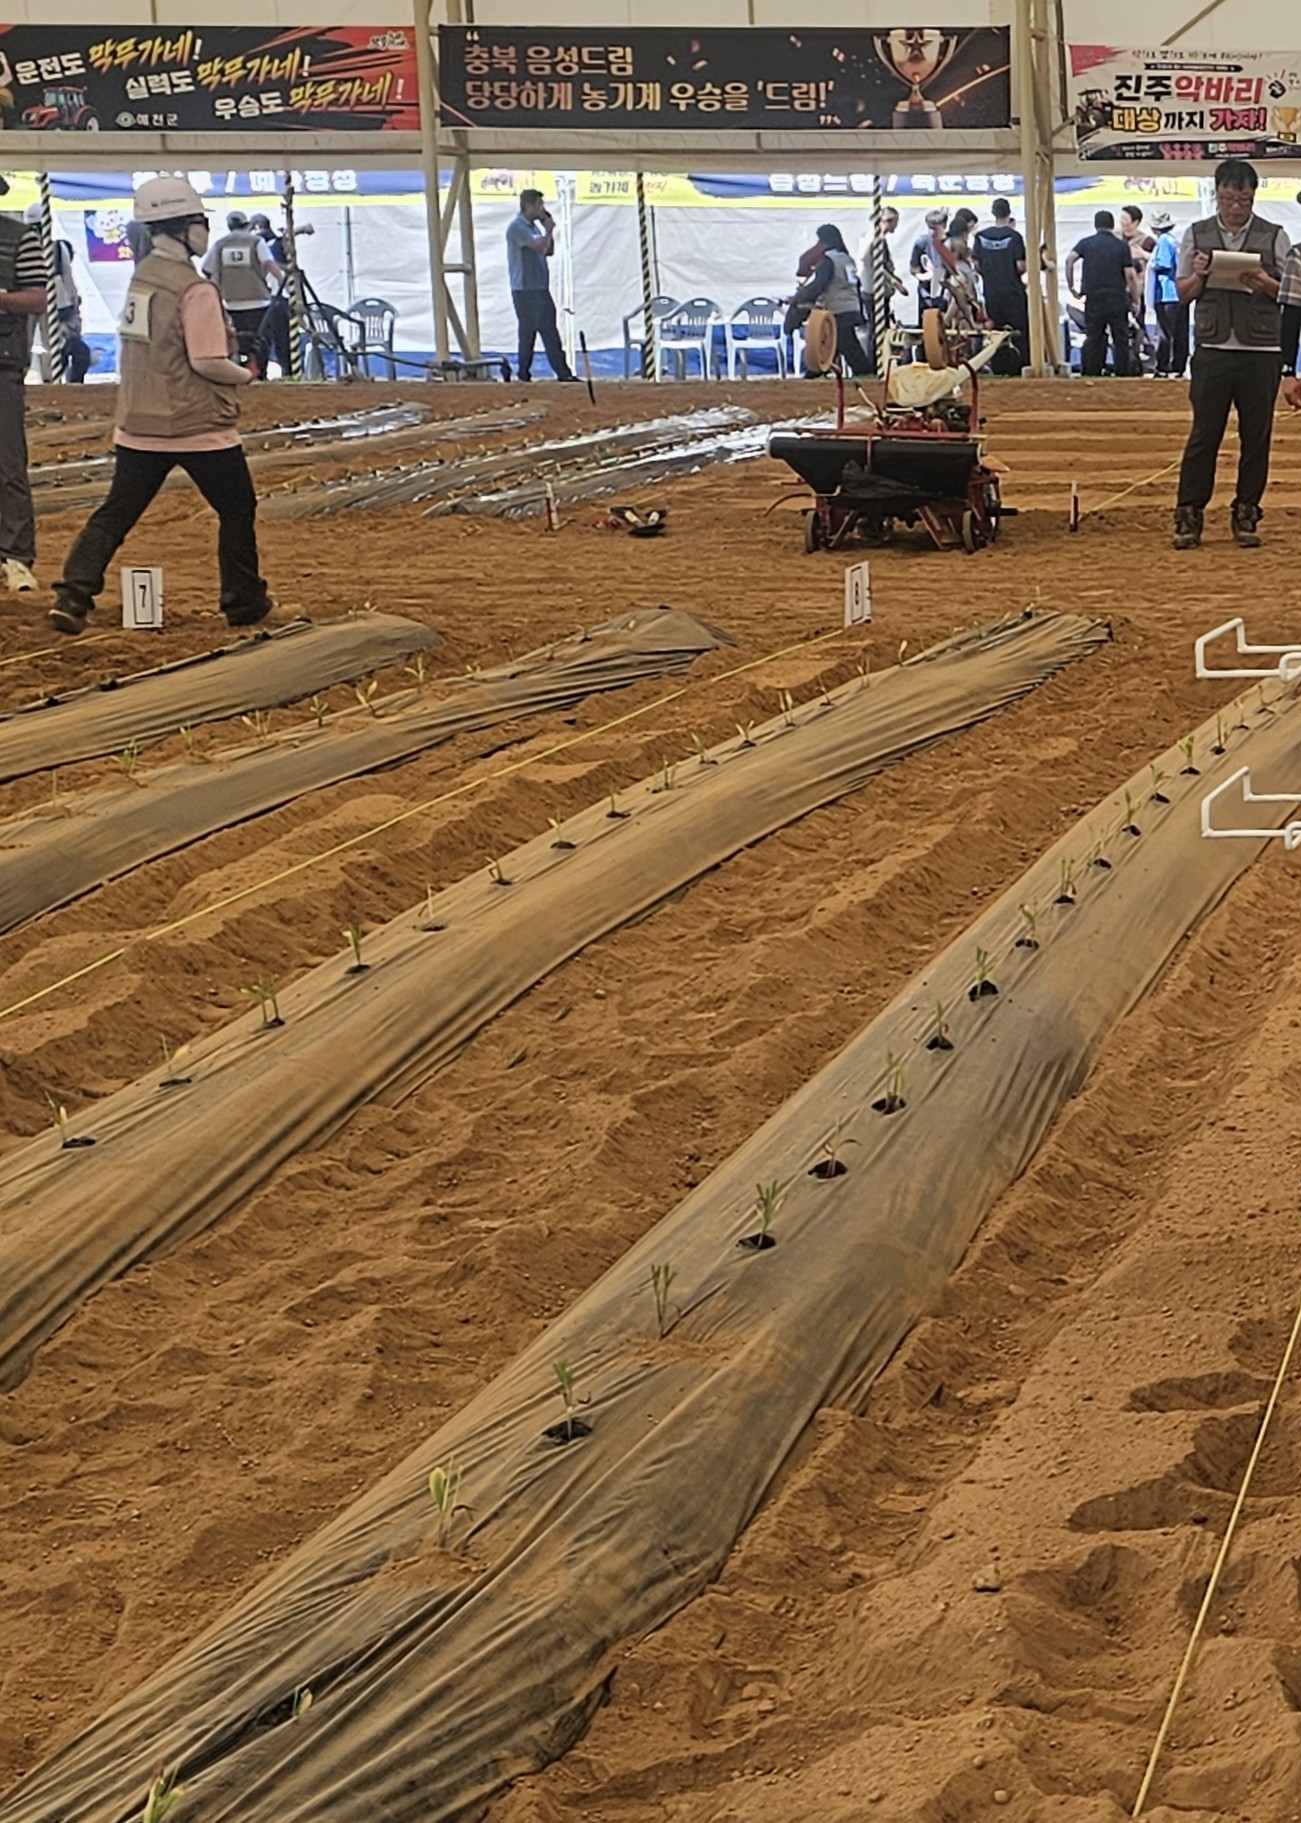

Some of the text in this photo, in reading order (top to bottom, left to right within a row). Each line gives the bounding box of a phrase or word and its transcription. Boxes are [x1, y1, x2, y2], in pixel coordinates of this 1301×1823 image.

[15, 30, 202, 85] 운전도 막무가네!
[464, 45, 634, 76] 충북 음성드림
[125, 47, 312, 100] 실력도 막무가네!
[214, 71, 405, 120] 우승도 막무가네!
[465, 81, 573, 111] 당당하게
[581, 82, 661, 111] 농기계
[669, 82, 750, 112] 우승을
[1113, 75, 1265, 104] 진주악바리
[136, 113, 179, 126] 예천군
[1209, 107, 1268, 131] 가자!
[138, 584, 147, 608] 7
